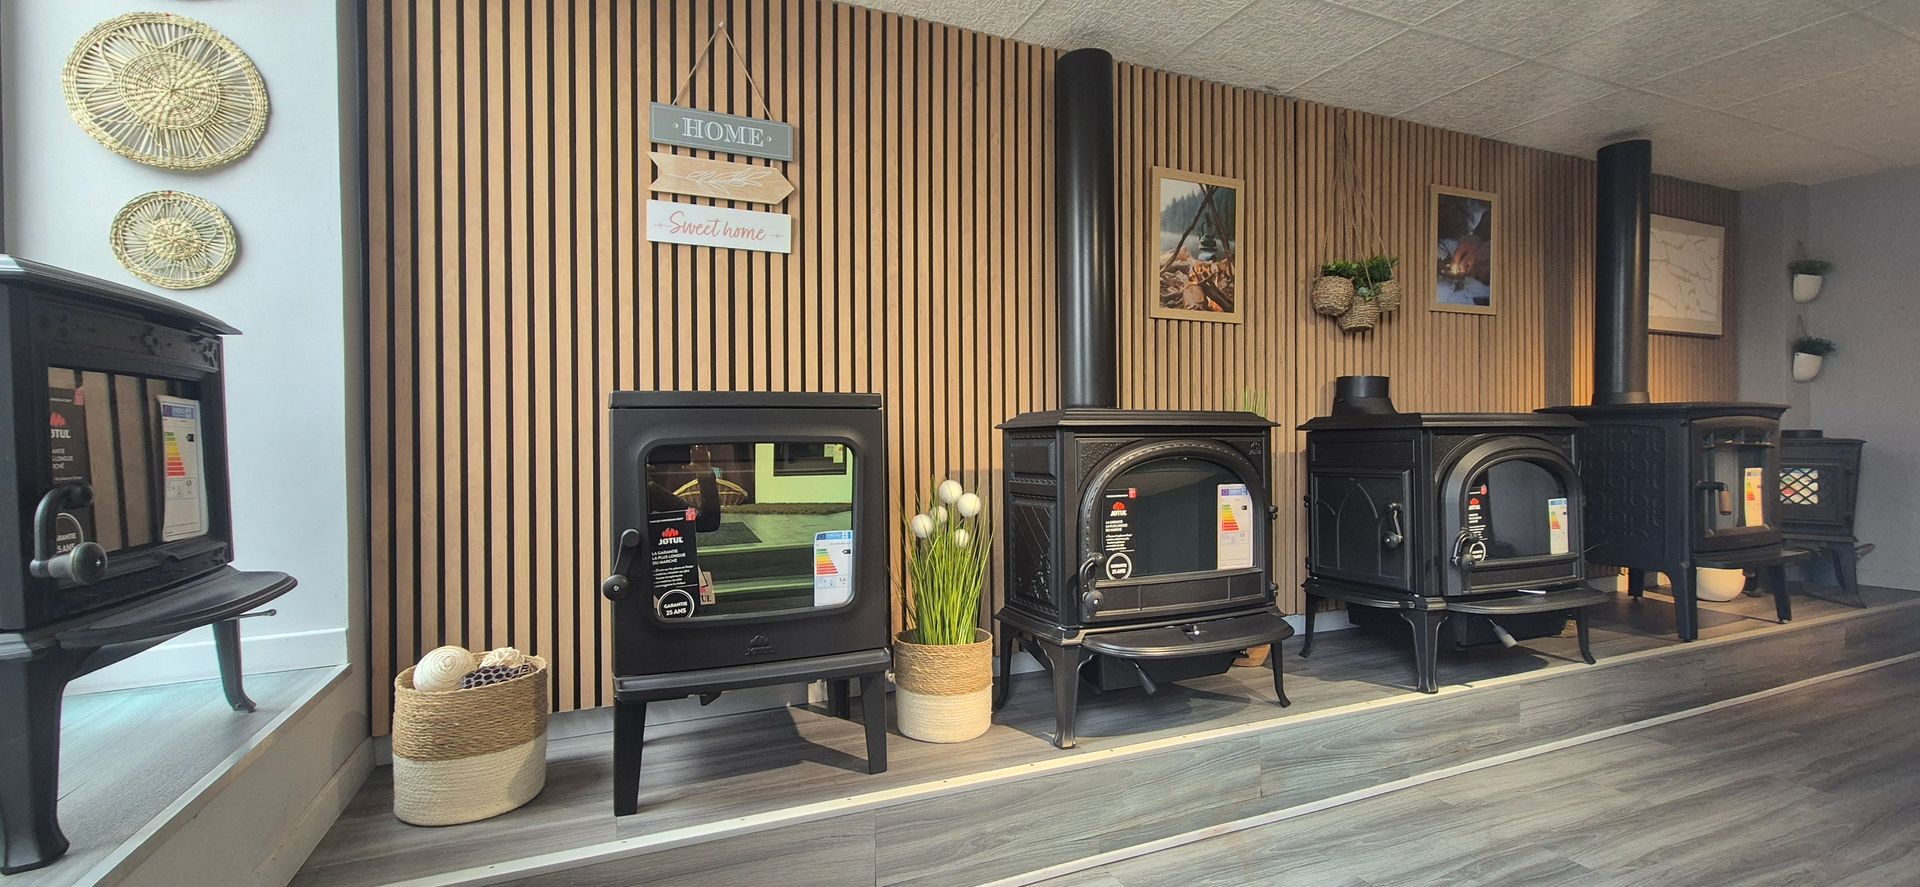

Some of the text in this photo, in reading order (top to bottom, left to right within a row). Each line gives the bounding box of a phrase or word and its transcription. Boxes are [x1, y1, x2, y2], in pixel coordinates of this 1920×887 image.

[682, 117, 764, 147] HOME
[669, 210, 767, 241] Sweet home
[658, 536, 684, 546] JØTUL
[663, 601, 688, 609] GARANTIE
[673, 607, 687, 615] ANS
